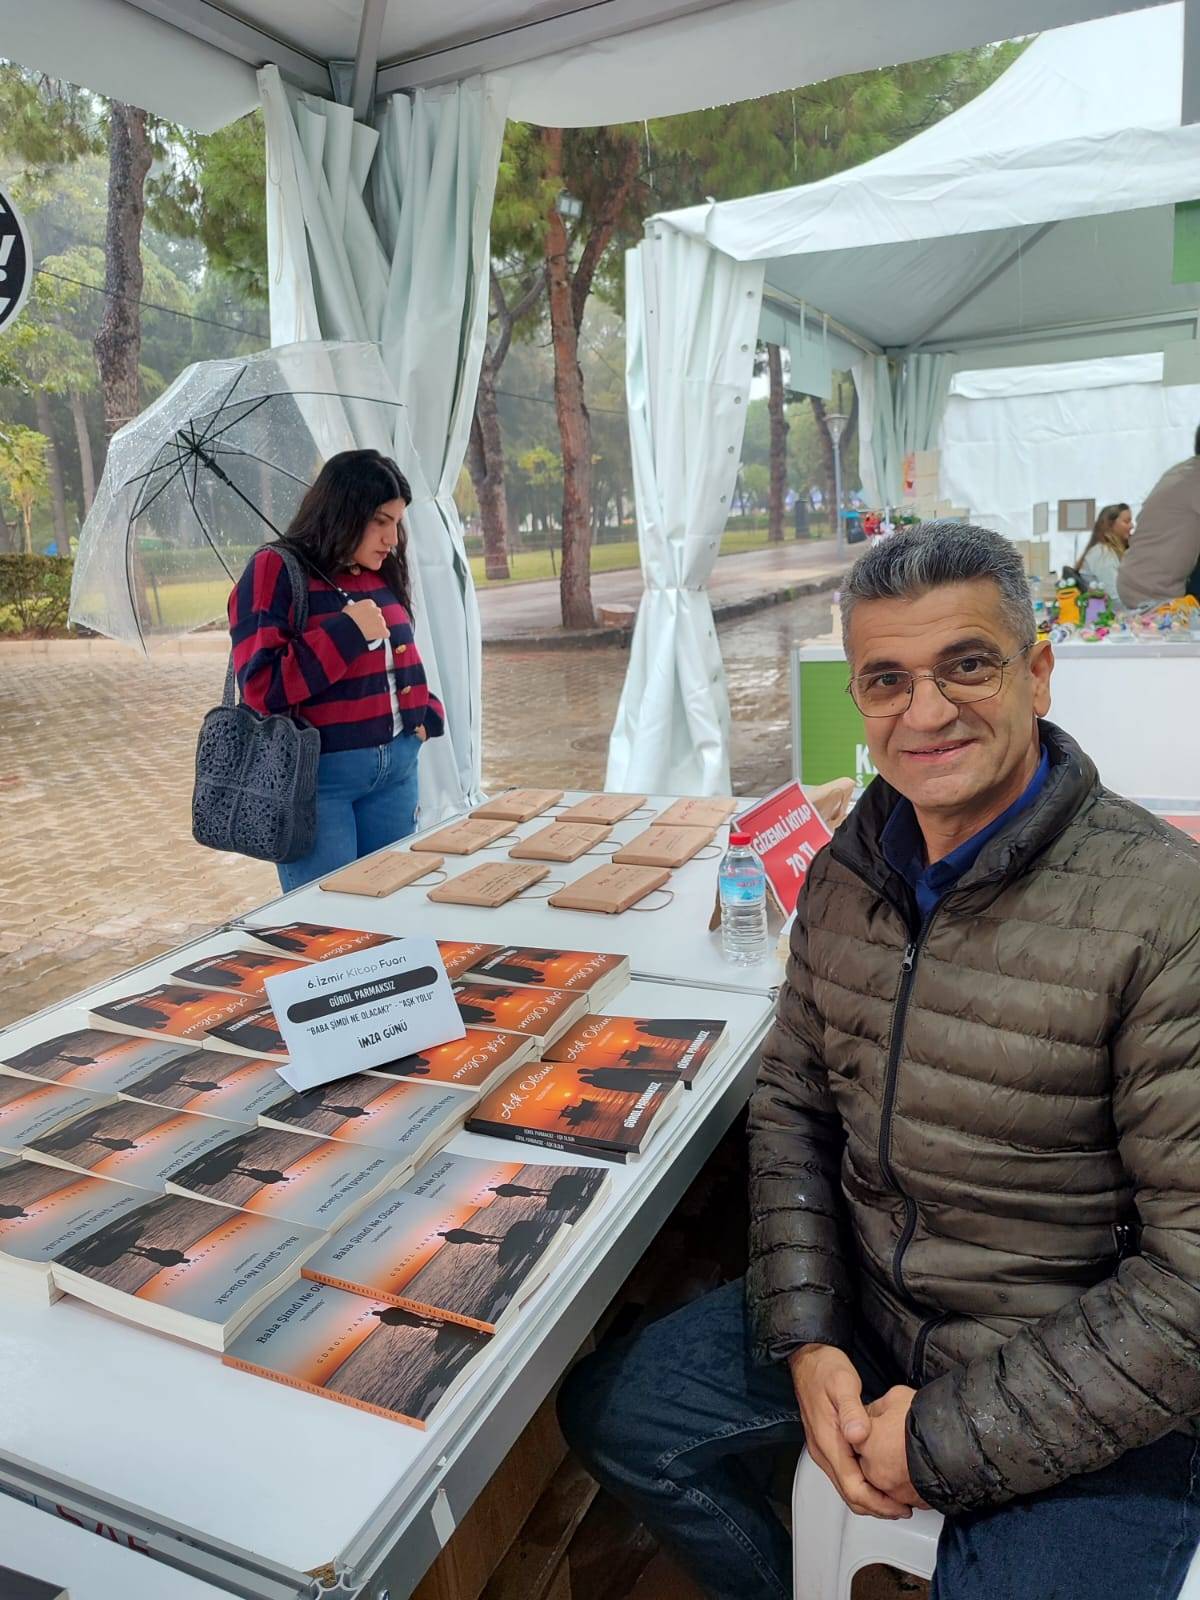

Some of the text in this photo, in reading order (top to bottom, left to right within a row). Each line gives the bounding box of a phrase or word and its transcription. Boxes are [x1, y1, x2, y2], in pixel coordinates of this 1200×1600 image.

[752, 804, 812, 855] GİZEMLİ KİTAP
[786, 853, 807, 878] 70
[307, 955, 407, 989] 6. İzmir Kitap Fuarı
[328, 980, 397, 1008] GÜROL PARMAKSIZ
[329, 1015, 351, 1032] ŞİMDİ
[350, 1013, 360, 1025] NE
[358, 1018, 409, 1049] İMZA GÜNÜ
[517, 1005, 549, 1030] Olsun
[567, 1039, 592, 1061] Aşk
[582, 1017, 613, 1039] Olsun
[452, 1054, 489, 1081] Olsun
[501, 1092, 529, 1120] Aşk
[519, 1064, 554, 1091] Olsun
[623, 1081, 662, 1128] GÜROL PARMAKSIZ
[332, 1242, 354, 1261] Baba
[368, 1217, 383, 1228] Ne
[378, 1200, 405, 1220] Olacak
[214, 1279, 248, 1306] Olacak
[255, 1323, 281, 1345] Baba
[276, 1302, 303, 1324] Şimdi
[299, 1291, 315, 1304] Ne
